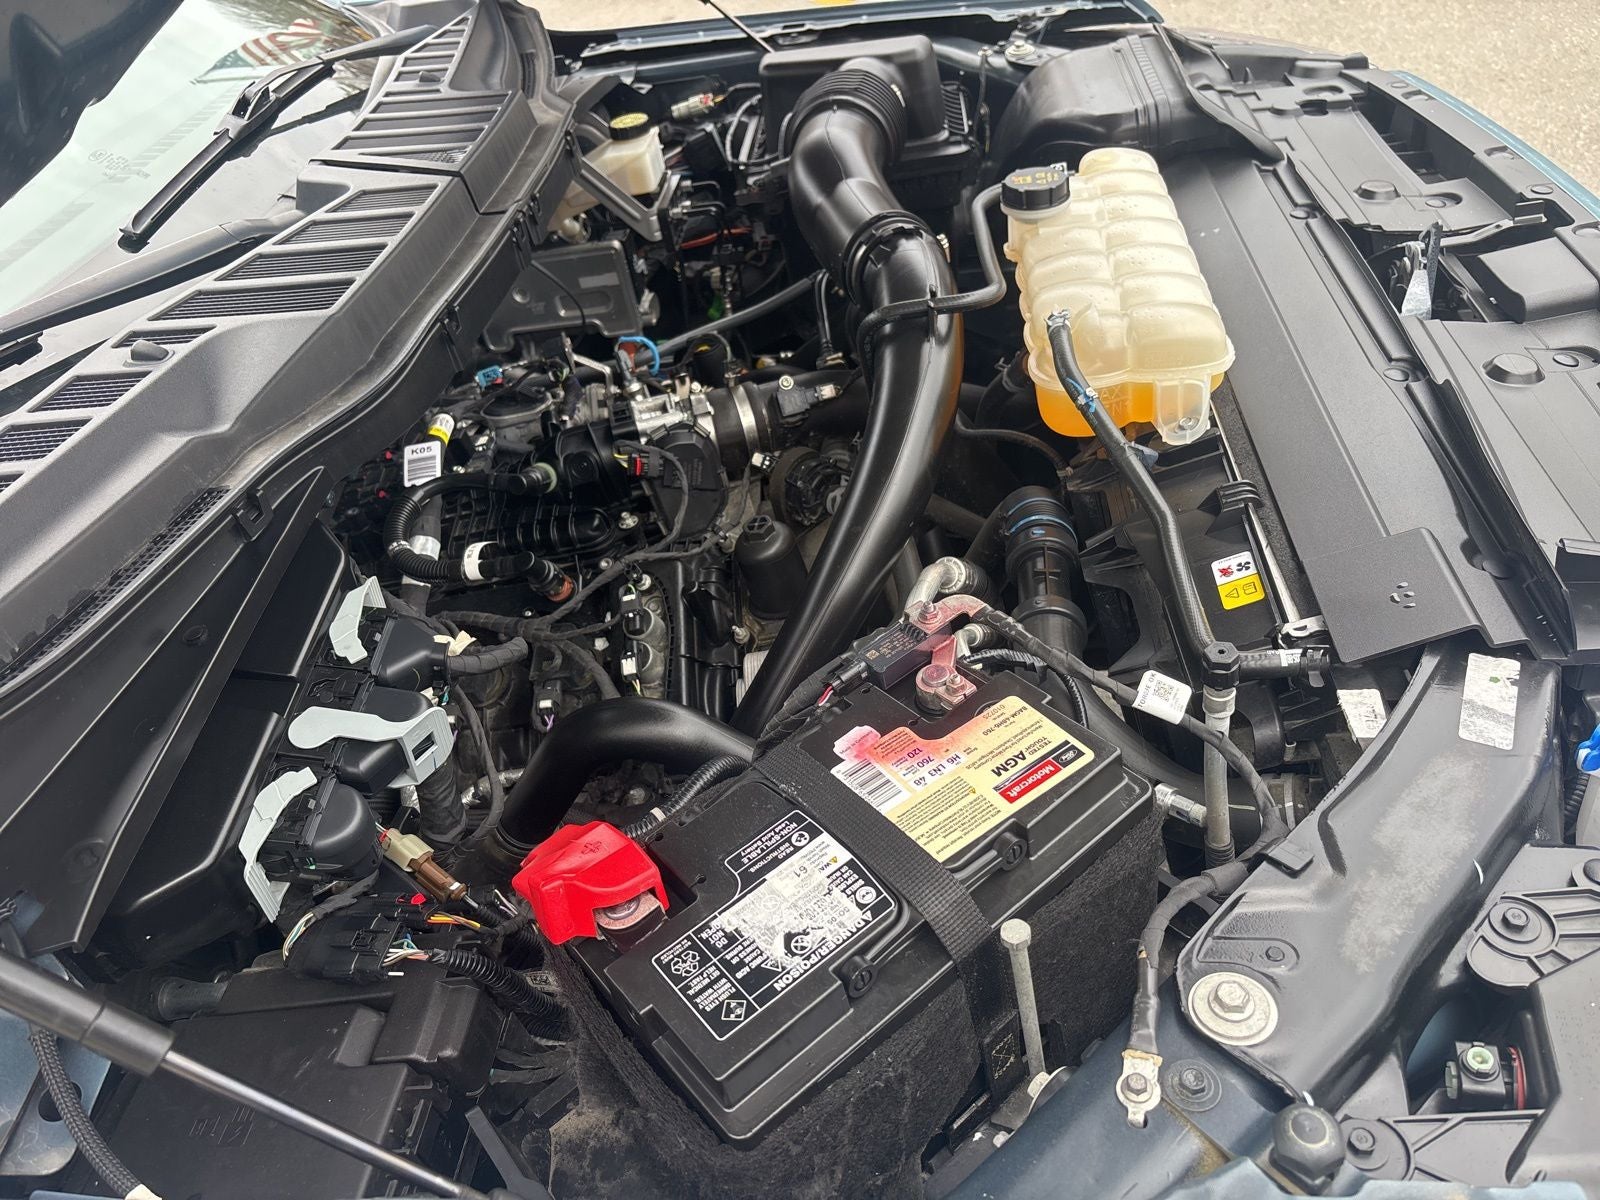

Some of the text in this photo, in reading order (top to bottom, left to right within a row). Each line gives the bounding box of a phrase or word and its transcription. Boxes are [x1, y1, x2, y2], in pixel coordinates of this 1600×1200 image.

[411, 446, 432, 455] K05
[1148, 672, 1157, 682] OK
[982, 704, 1005, 720] 010725
[906, 747, 922, 759] 120
[1028, 739, 1052, 755] TESTED
[916, 755, 934, 768] 760
[946, 754, 961, 765] H6
[991, 750, 1029, 777] AGM
[927, 764, 946, 777] LN3
[913, 776, 928, 786] 48
[1006, 764, 1055, 798] Motorcraft
[740, 820, 789, 857] Lead Acid Battery
[741, 821, 798, 865] NON-SPILLABLE
[748, 841, 790, 874] INSTRUCTIONS.
[777, 846, 794, 859] READ
[792, 865, 809, 879] 61
[840, 865, 848, 873] OR
[843, 869, 853, 879] CAN
[845, 878, 864, 895] SHIELD
[698, 921, 721, 941] OPEN.
[707, 929, 724, 944] NOT
[715, 936, 728, 948] DO
[660, 943, 682, 960] RECYCLED
[662, 940, 691, 964] BATTERY MUST
[723, 944, 743, 961] BURNS.
[743, 948, 761, 964] CAUSE
[772, 916, 866, 992] DANGER/POISON
[730, 956, 740, 965] OR
[688, 965, 716, 988] HELP FAST.
[735, 965, 751, 979] ACID
[687, 969, 720, 996] GET MEDICAL
[693, 977, 727, 1004] WITH WATER.
[697, 981, 731, 1009] IMMEDIATELY
[704, 986, 736, 1012] FLUSH EYES
